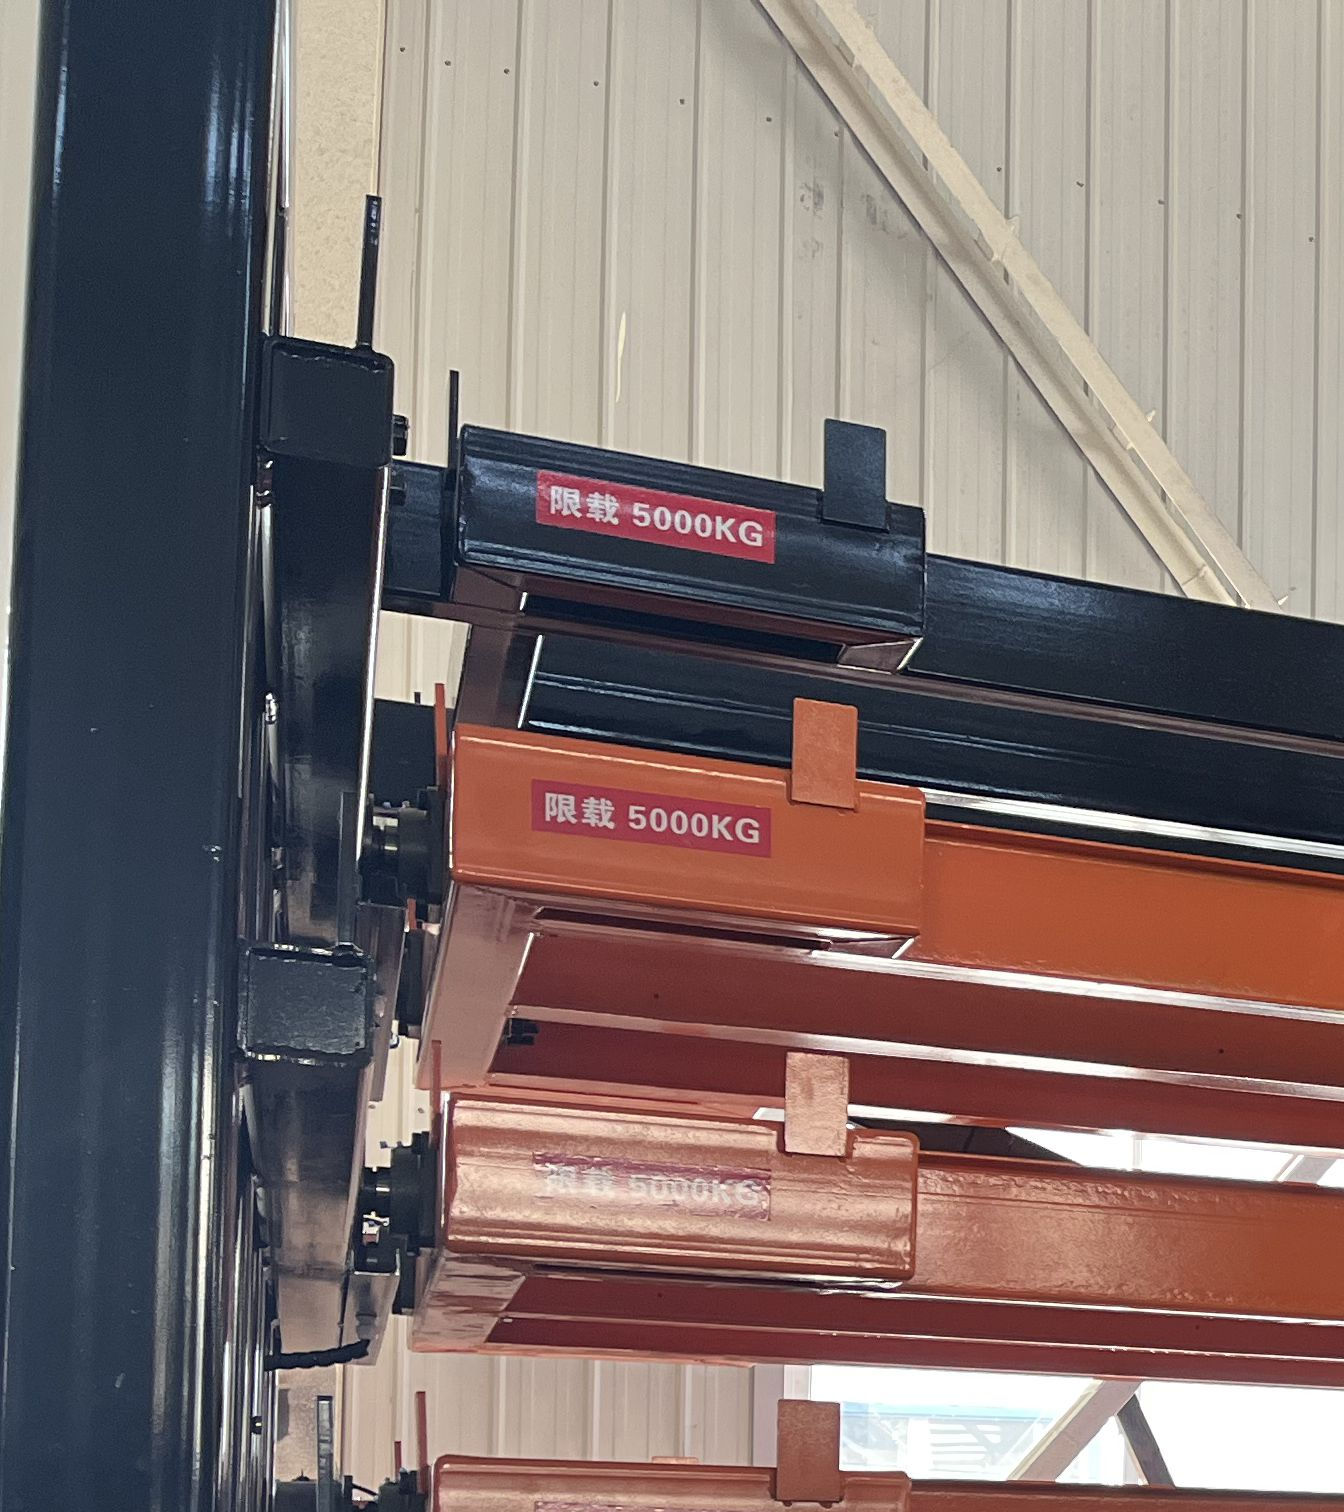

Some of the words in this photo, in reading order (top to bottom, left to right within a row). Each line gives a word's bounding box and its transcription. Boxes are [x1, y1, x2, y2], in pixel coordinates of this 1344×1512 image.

[549, 485, 619, 526] 限载
[632, 502, 763, 547] 5000KG
[544, 792, 615, 830] 限载
[628, 805, 760, 844] 5000KG
